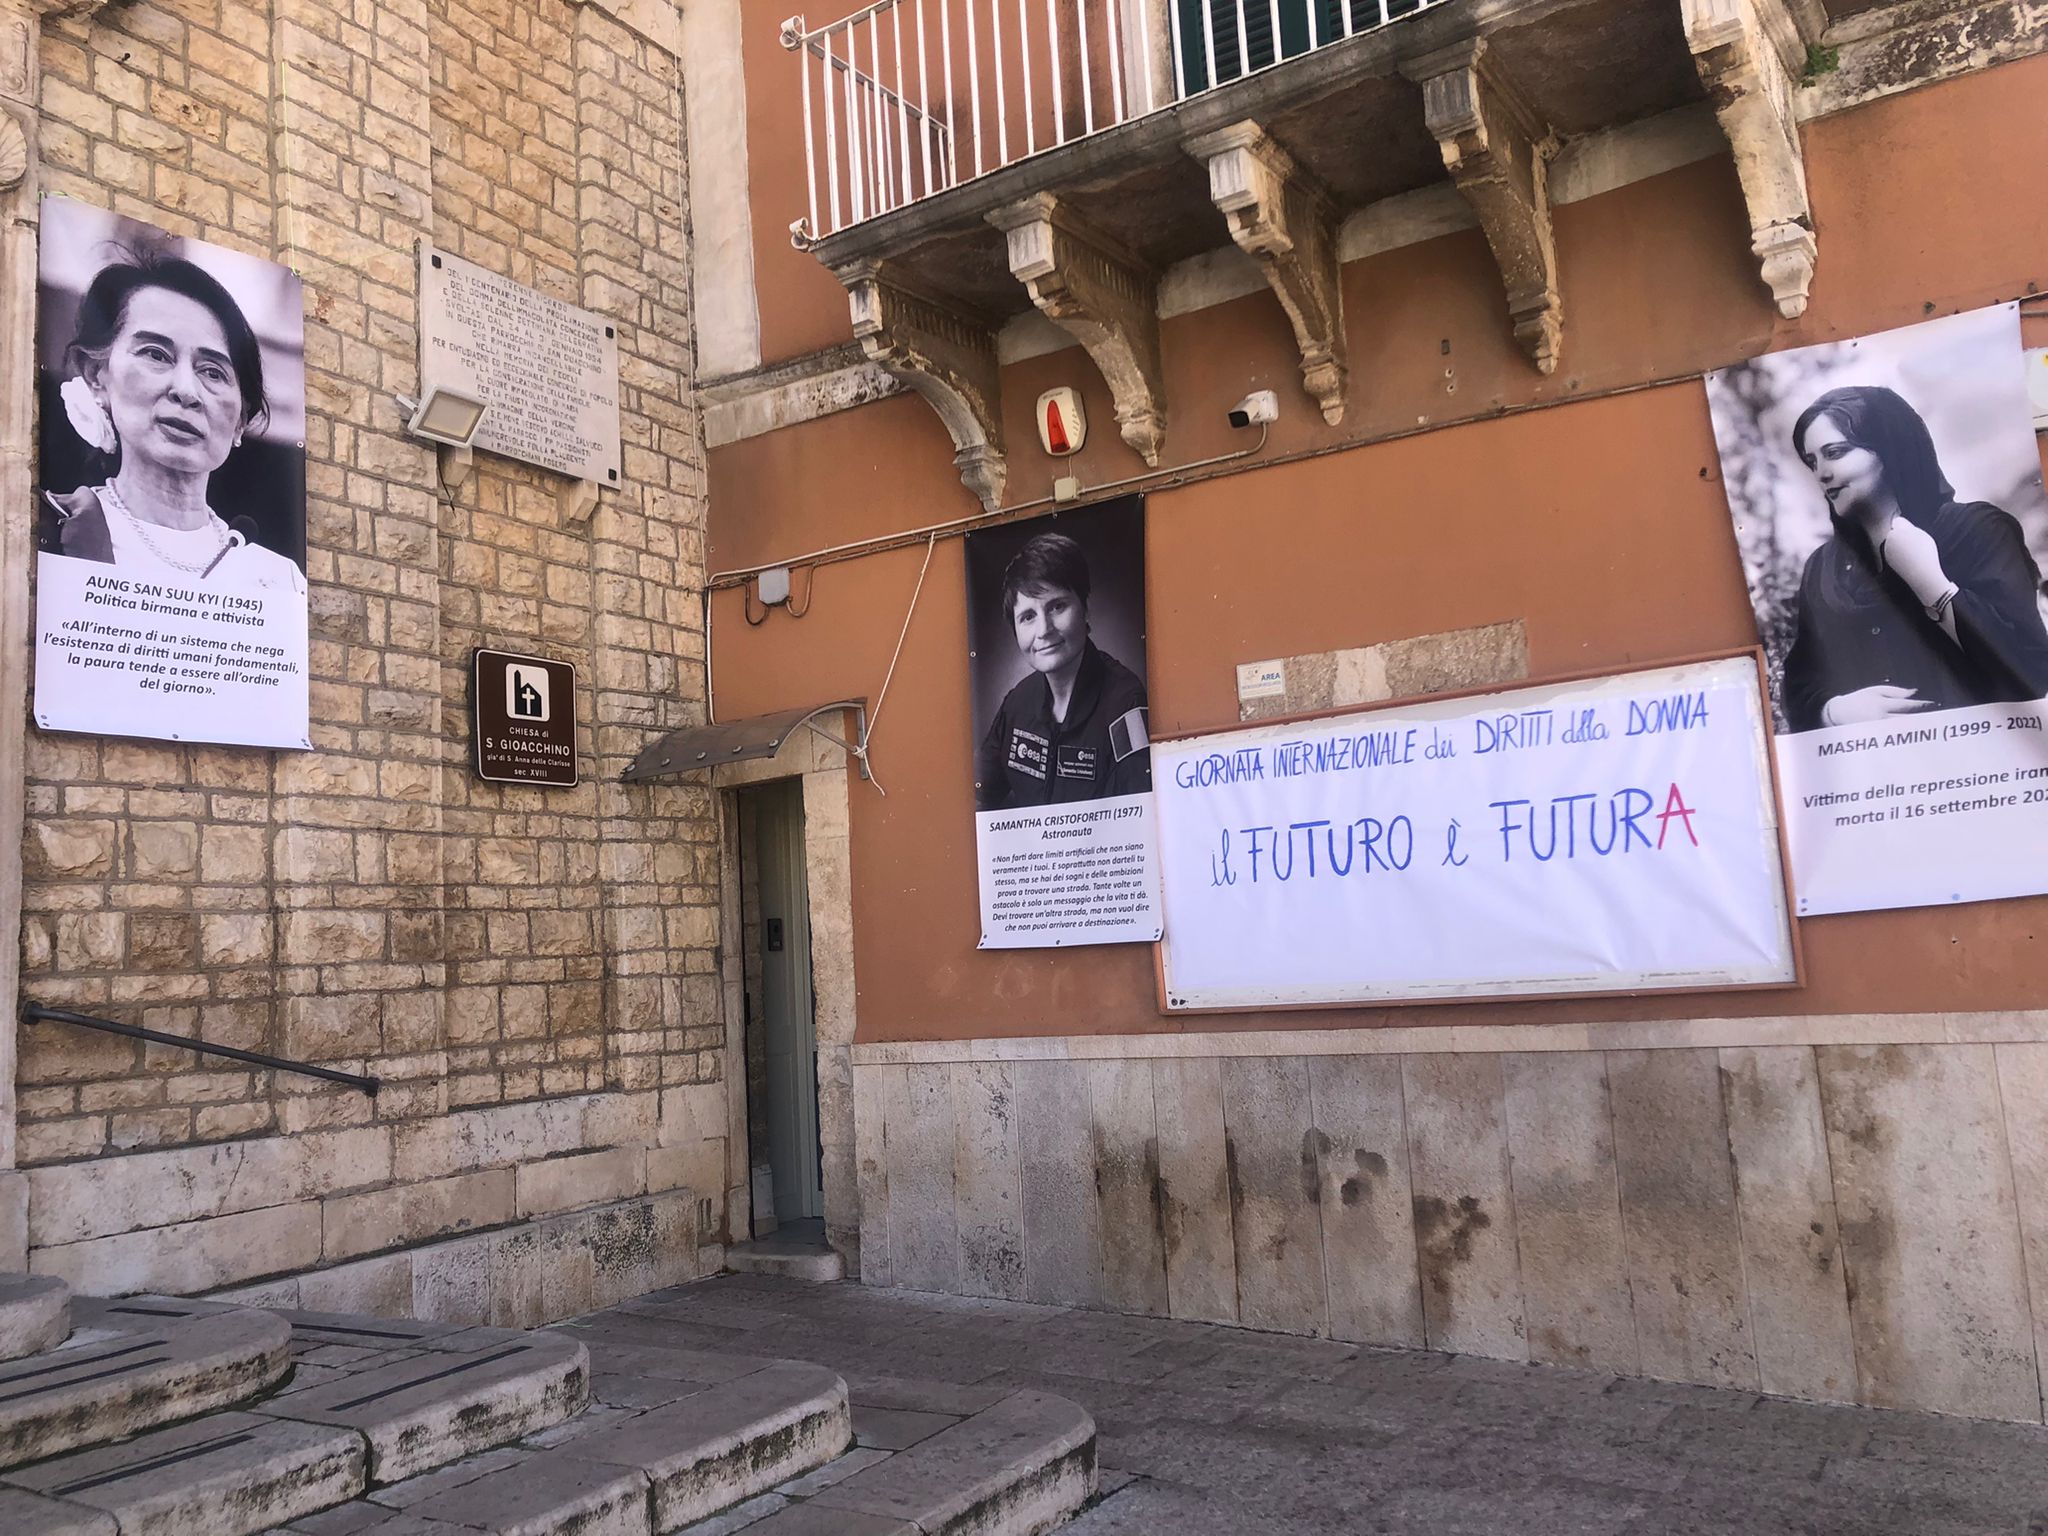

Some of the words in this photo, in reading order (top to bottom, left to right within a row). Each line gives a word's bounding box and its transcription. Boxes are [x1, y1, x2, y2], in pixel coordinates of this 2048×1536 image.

[86, 575, 129, 592] AUNG
[133, 583, 162, 596] SAN
[165, 588, 194, 602] SUU
[198, 593, 218, 605] KYI
[222, 598, 263, 613] (1945)
[85, 592, 136, 609] Politica
[141, 599, 197, 618] birmana
[202, 611, 208, 619] e
[213, 611, 264, 626] attivista
[145, 630, 158, 641] di
[161, 634, 176, 644] un
[180, 636, 227, 650] sistema
[231, 641, 251, 653] che
[255, 646, 284, 658] nega
[68, 653, 80, 664] la
[84, 658, 124, 670] paura
[129, 661, 165, 675] tende
[170, 667, 177, 676] a
[181, 668, 220, 680] essere
[118, 644, 130, 655] di
[134, 645, 169, 659] diritti
[173, 650, 212, 663] umani
[215, 654, 299, 674] fondamentali,
[1261, 673, 1280, 681] AREA
[140, 678, 159, 689] del
[163, 681, 216, 696] giorno».
[510, 727, 539, 737] CHIESA
[1176, 748, 1264, 788] GIORNATA
[1273, 729, 1416, 778] INTERNAZIONALE
[1425, 727, 1456, 760] dei
[1473, 710, 1552, 753] DIRITTI
[1562, 709, 1610, 743] della
[1625, 692, 1709, 736] DONNA
[1819, 737, 1878, 757] MASHA
[1884, 728, 1937, 747] AMINI
[1943, 721, 1991, 741] (1999
[2007, 716, 2042, 731] 2022)
[500, 739, 570, 756] GIOACCHINO
[548, 759, 570, 767] Clarisse
[530, 769, 547, 777] XVIII
[1803, 793, 1859, 808] Vittima
[1866, 784, 1904, 800] della
[1911, 770, 2009, 794] repressione
[990, 818, 1041, 831] SAMANTHA
[1044, 810, 1111, 826] CRISTOFORETTI
[1114, 806, 1143, 821] (1977)
[1835, 812, 1884, 826] morta
[1891, 807, 1899, 820] il
[1905, 804, 1924, 818] 16
[1930, 795, 2017, 815] settembre
[1042, 827, 1092, 839] Astronauta
[1211, 829, 1236, 886] il
[1240, 815, 1412, 882] FUTURO
[1442, 818, 1468, 866] è
[1489, 783, 1698, 862] FUTURA
[1011, 853, 1026, 863] farti
[1028, 851, 1043, 860] dare
[1045, 850, 1063, 859] limiti
[1065, 847, 1095, 858] artificiali
[1096, 845, 1108, 853] che
[1110, 844, 1123, 852] non
[1125, 843, 1143, 851] siano
[992, 865, 1028, 874] veramente
[1034, 863, 1050, 871] tuoi.
[1058, 859, 1096, 870] soprattutto
[1112, 856, 1135, 864] darteli
[995, 878, 1016, 886] stesso,
[1040, 874, 1051, 882] hai
[1053, 873, 1064, 881] dei
[1066, 872, 1084, 882] sogni
[1091, 869, 1107, 878] delle
[1109, 867, 1143, 876] ambizioni
[998, 889, 1017, 898] prova
[1025, 886, 1050, 895] trovare
[1067, 883, 1090, 892] strada.
[1093, 882, 1111, 890] Tante
[1113, 880, 1131, 889] volte
[993, 900, 1020, 909] ostacolo
[1028, 898, 1042, 906] solo
[1054, 896, 1091, 907] messaggio
[1107, 893, 1113, 901] la
[1115, 892, 1128, 900] vita
[993, 912, 1007, 920] Devi
[1009, 911, 1033, 919] trovare
[1064, 907, 1088, 916] strada,
[1118, 904, 1134, 912] vuol
[1136, 903, 1149, 911] dire
[1005, 923, 1016, 931] che
[1032, 921, 1047, 931] puoi
[1049, 920, 1076, 929] arrivare
